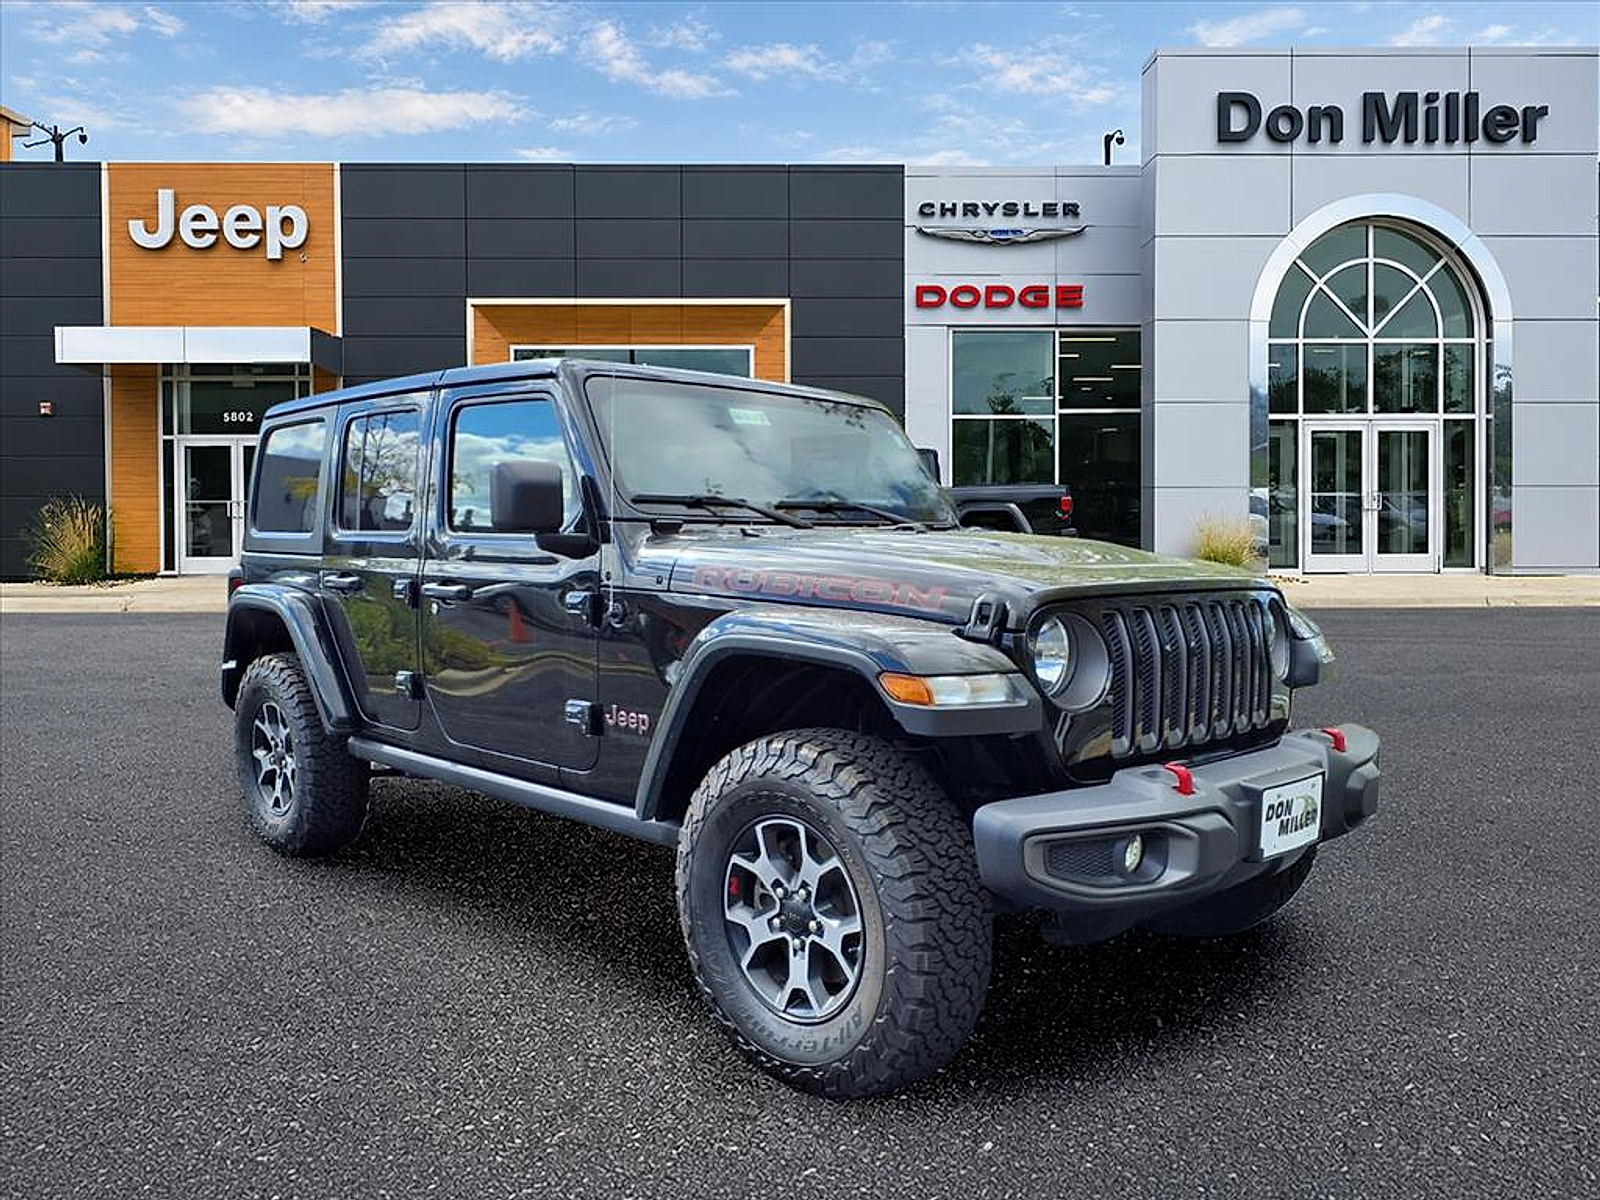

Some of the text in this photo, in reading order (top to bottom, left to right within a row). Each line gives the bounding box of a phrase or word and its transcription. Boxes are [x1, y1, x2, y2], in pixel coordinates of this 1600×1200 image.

[1217, 91, 1549, 143] Don Miller
[128, 188, 309, 260] Jeep
[918, 201, 1081, 218] CHRYSLER
[915, 284, 1084, 308] DODGE
[223, 411, 253, 422] 5802
[692, 564, 948, 609] RUBICON
[604, 704, 650, 735] Jeep
[1265, 798, 1294, 822] DON
[1278, 808, 1318, 837] MILLER
